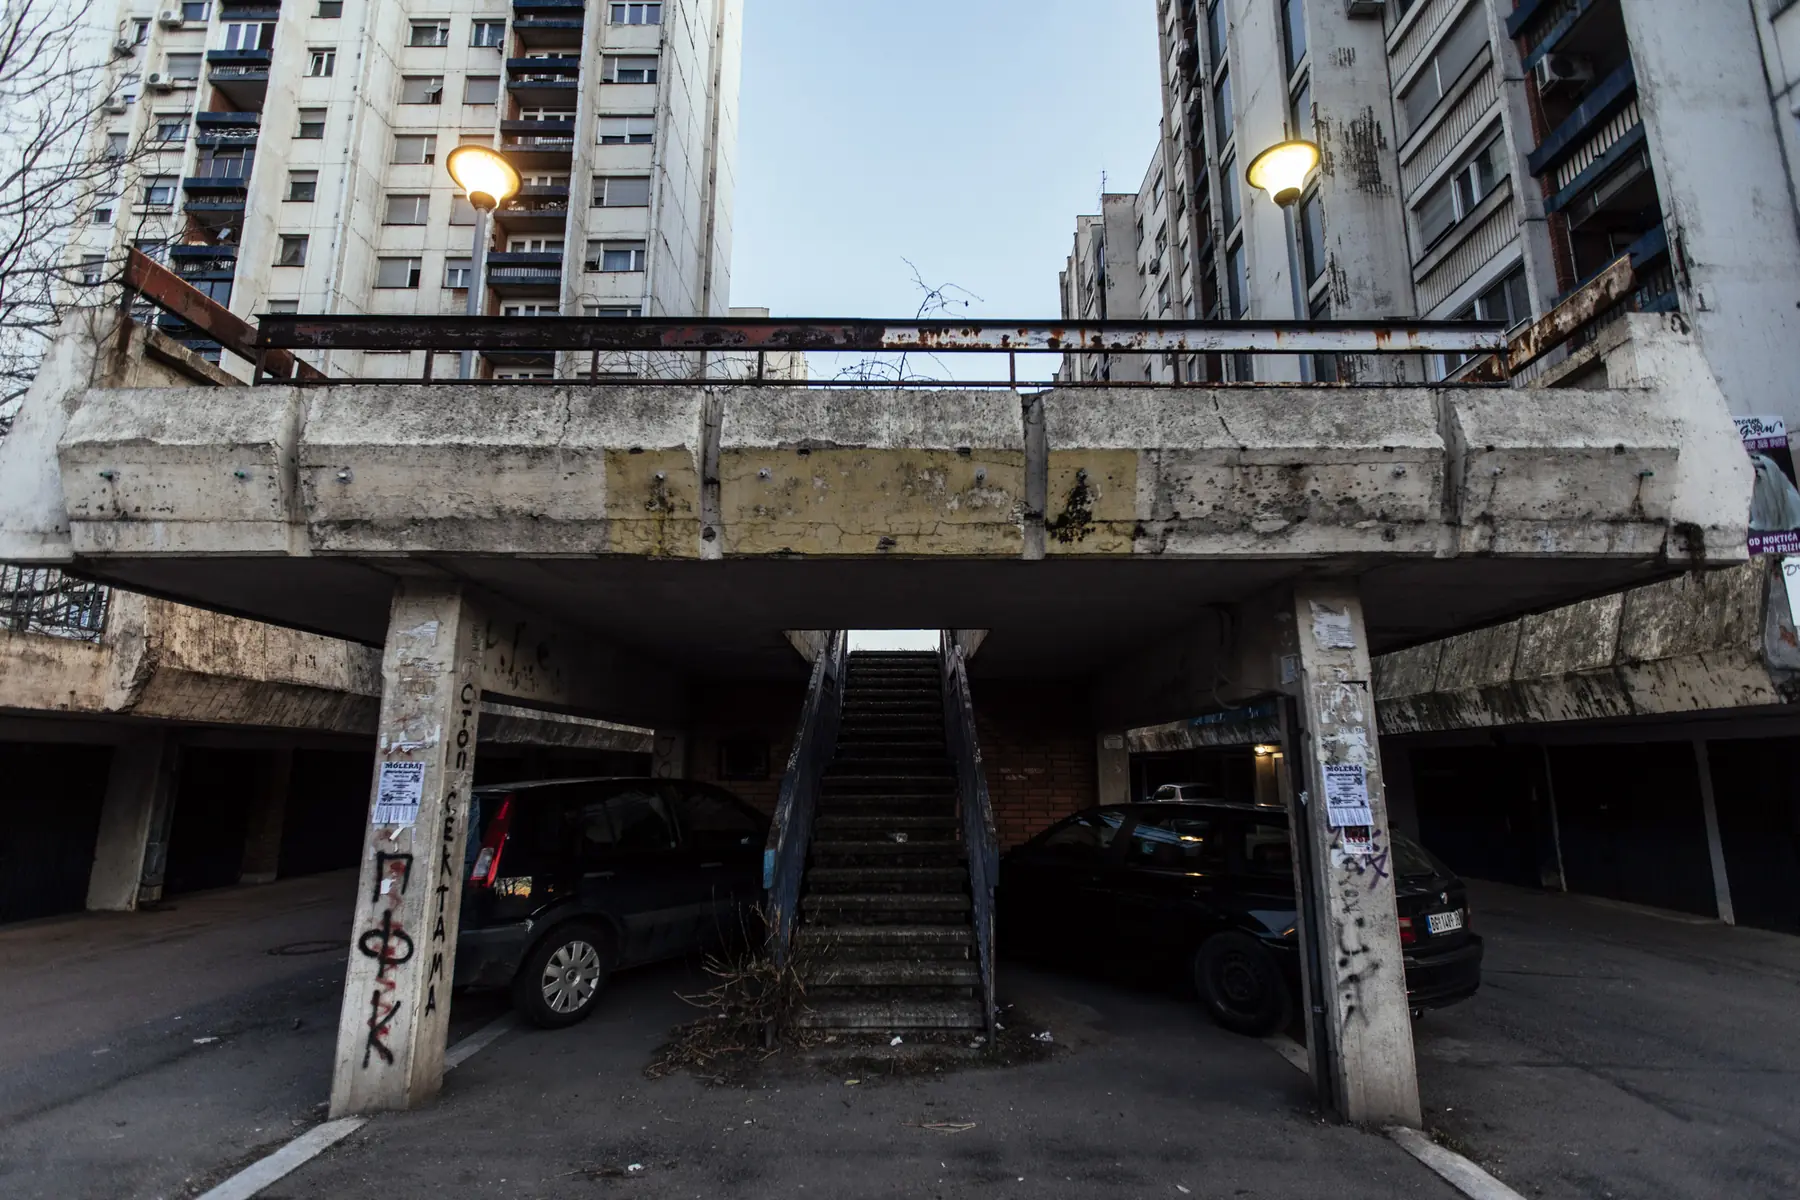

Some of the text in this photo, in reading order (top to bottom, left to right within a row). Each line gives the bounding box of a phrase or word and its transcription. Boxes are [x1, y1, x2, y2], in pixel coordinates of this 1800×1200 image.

[1749, 532, 1798, 546] OD NOKTIĆA
[385, 762, 422, 771] MOLERAJ
